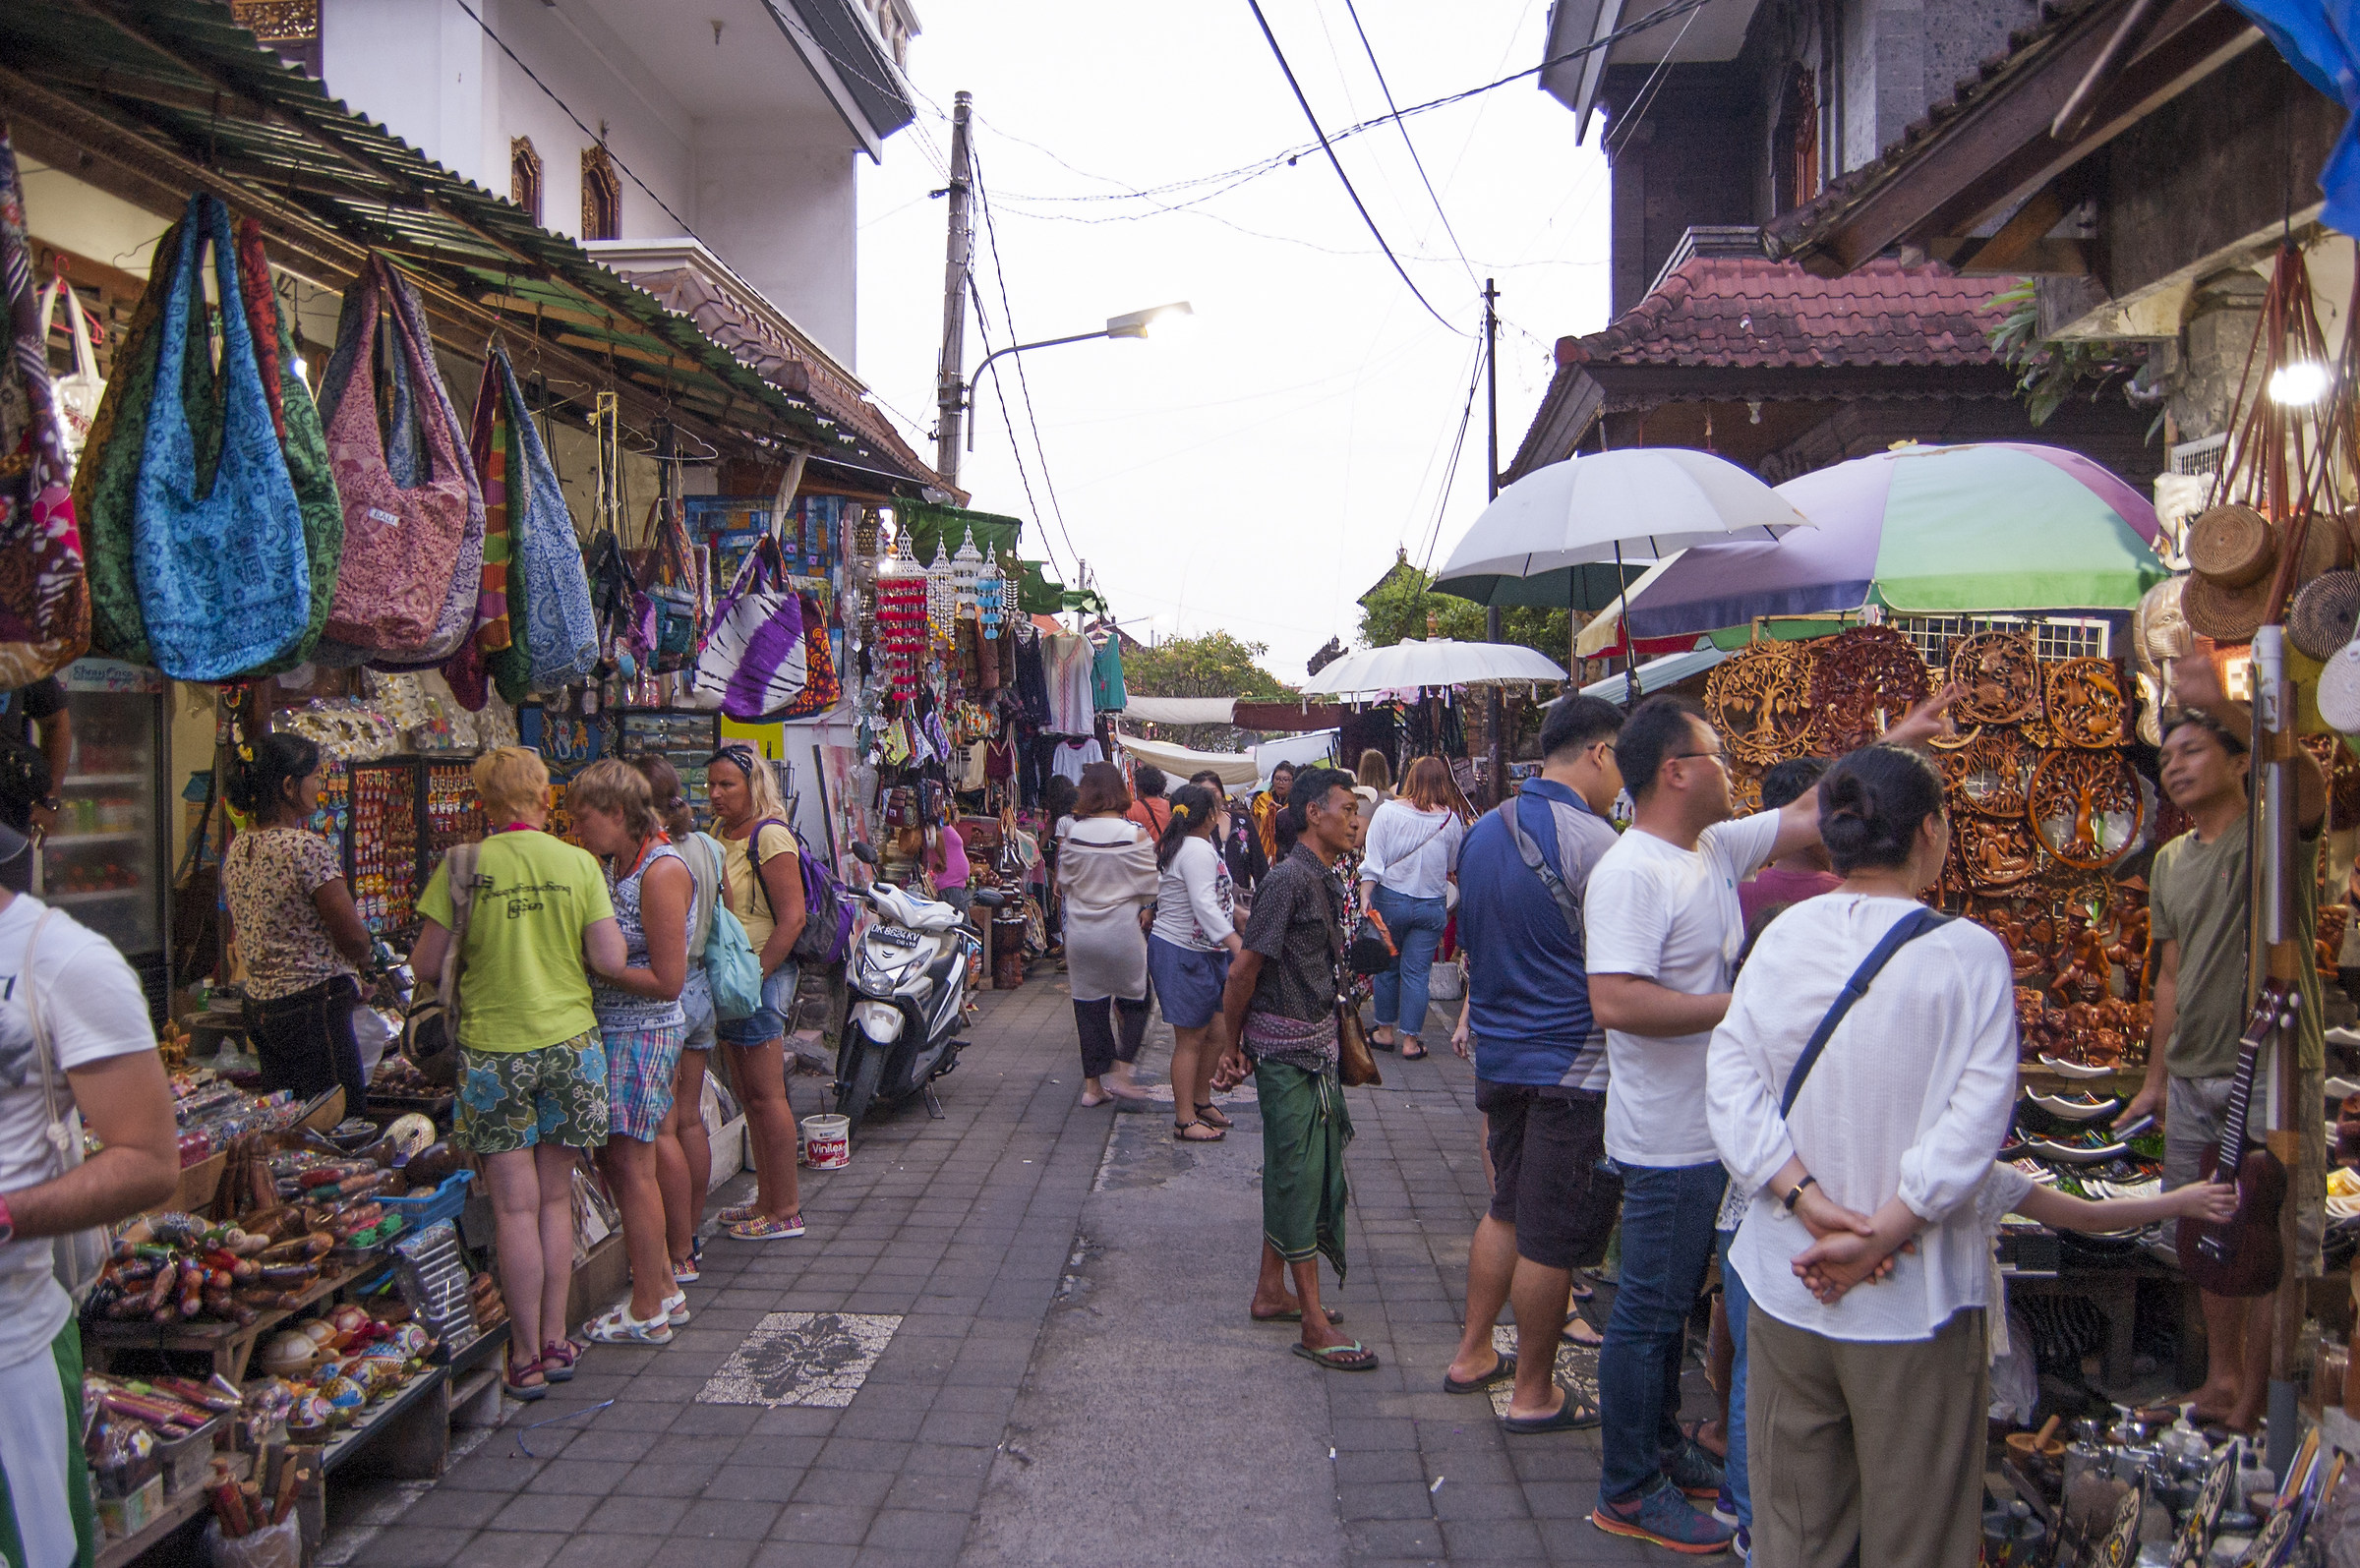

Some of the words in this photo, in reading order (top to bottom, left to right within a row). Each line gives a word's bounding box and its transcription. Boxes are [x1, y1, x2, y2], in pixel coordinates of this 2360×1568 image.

[374, 510, 395, 523] BALI
[871, 923, 884, 934] DK
[907, 931, 920, 941] KV
[812, 1142, 844, 1154] Vinilex
